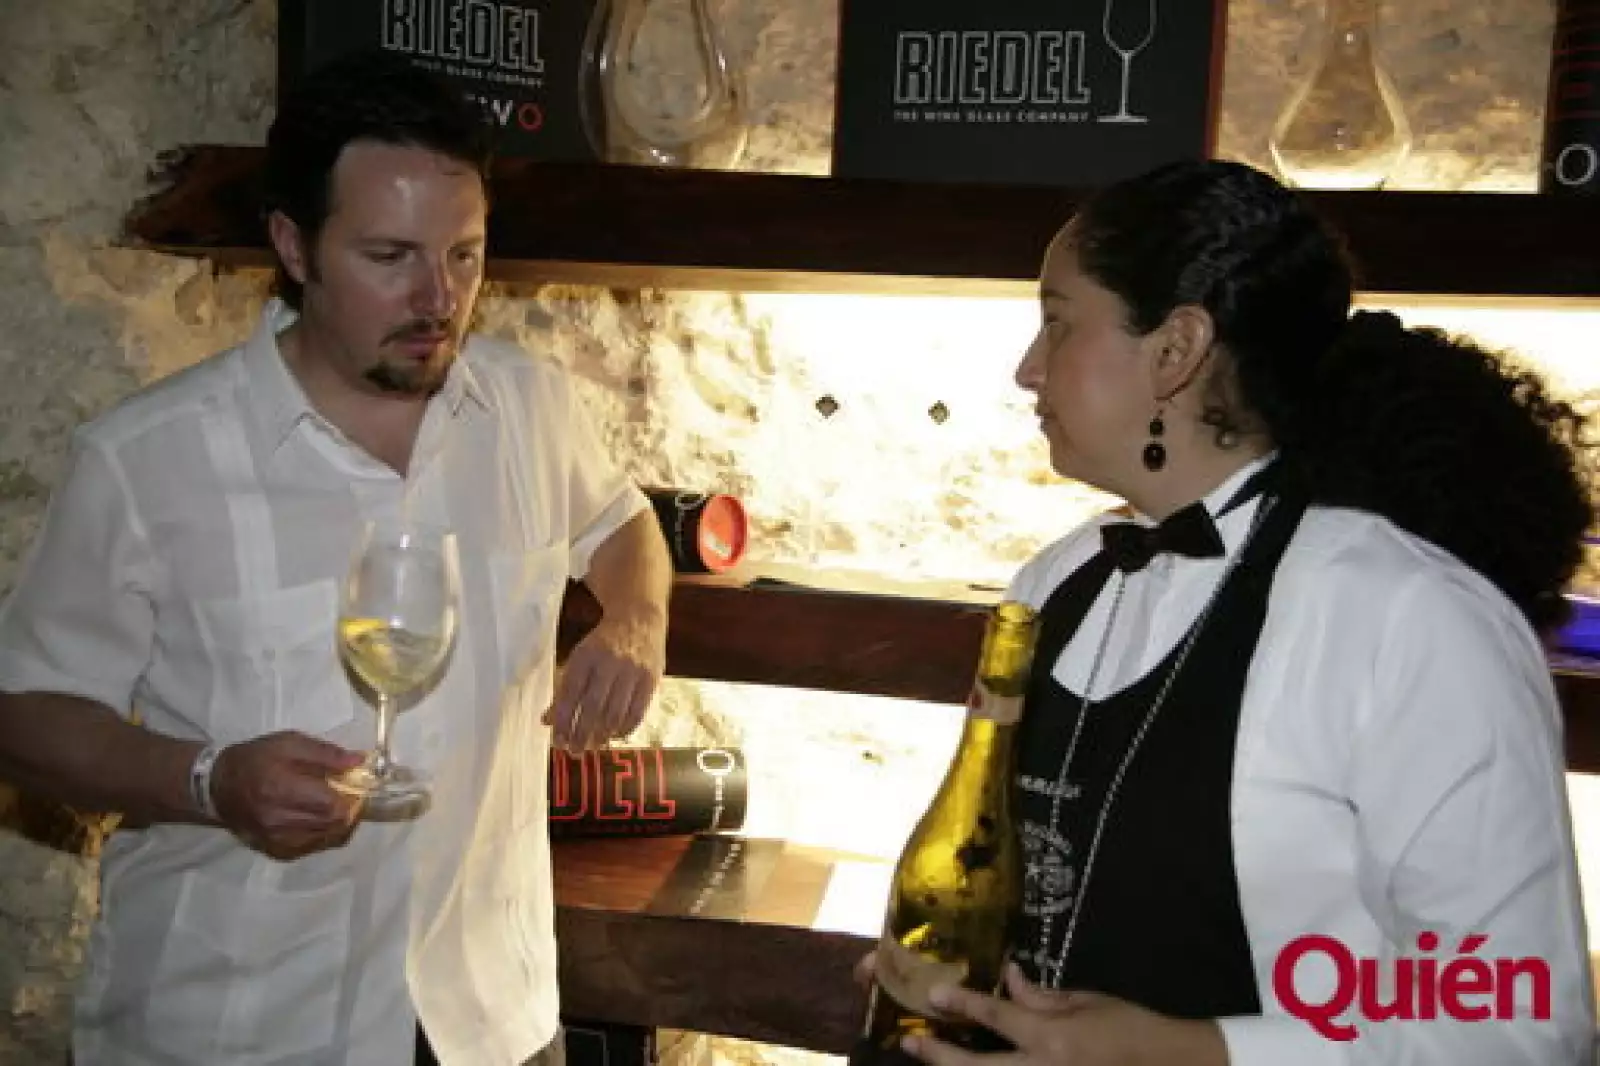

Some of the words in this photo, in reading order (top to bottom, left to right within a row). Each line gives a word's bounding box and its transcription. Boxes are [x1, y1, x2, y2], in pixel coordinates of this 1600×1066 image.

[381, 0, 545, 72] RIEDEL
[895, 31, 1091, 104] RIEDEL
[1016, 109, 1090, 123] COMPANY
